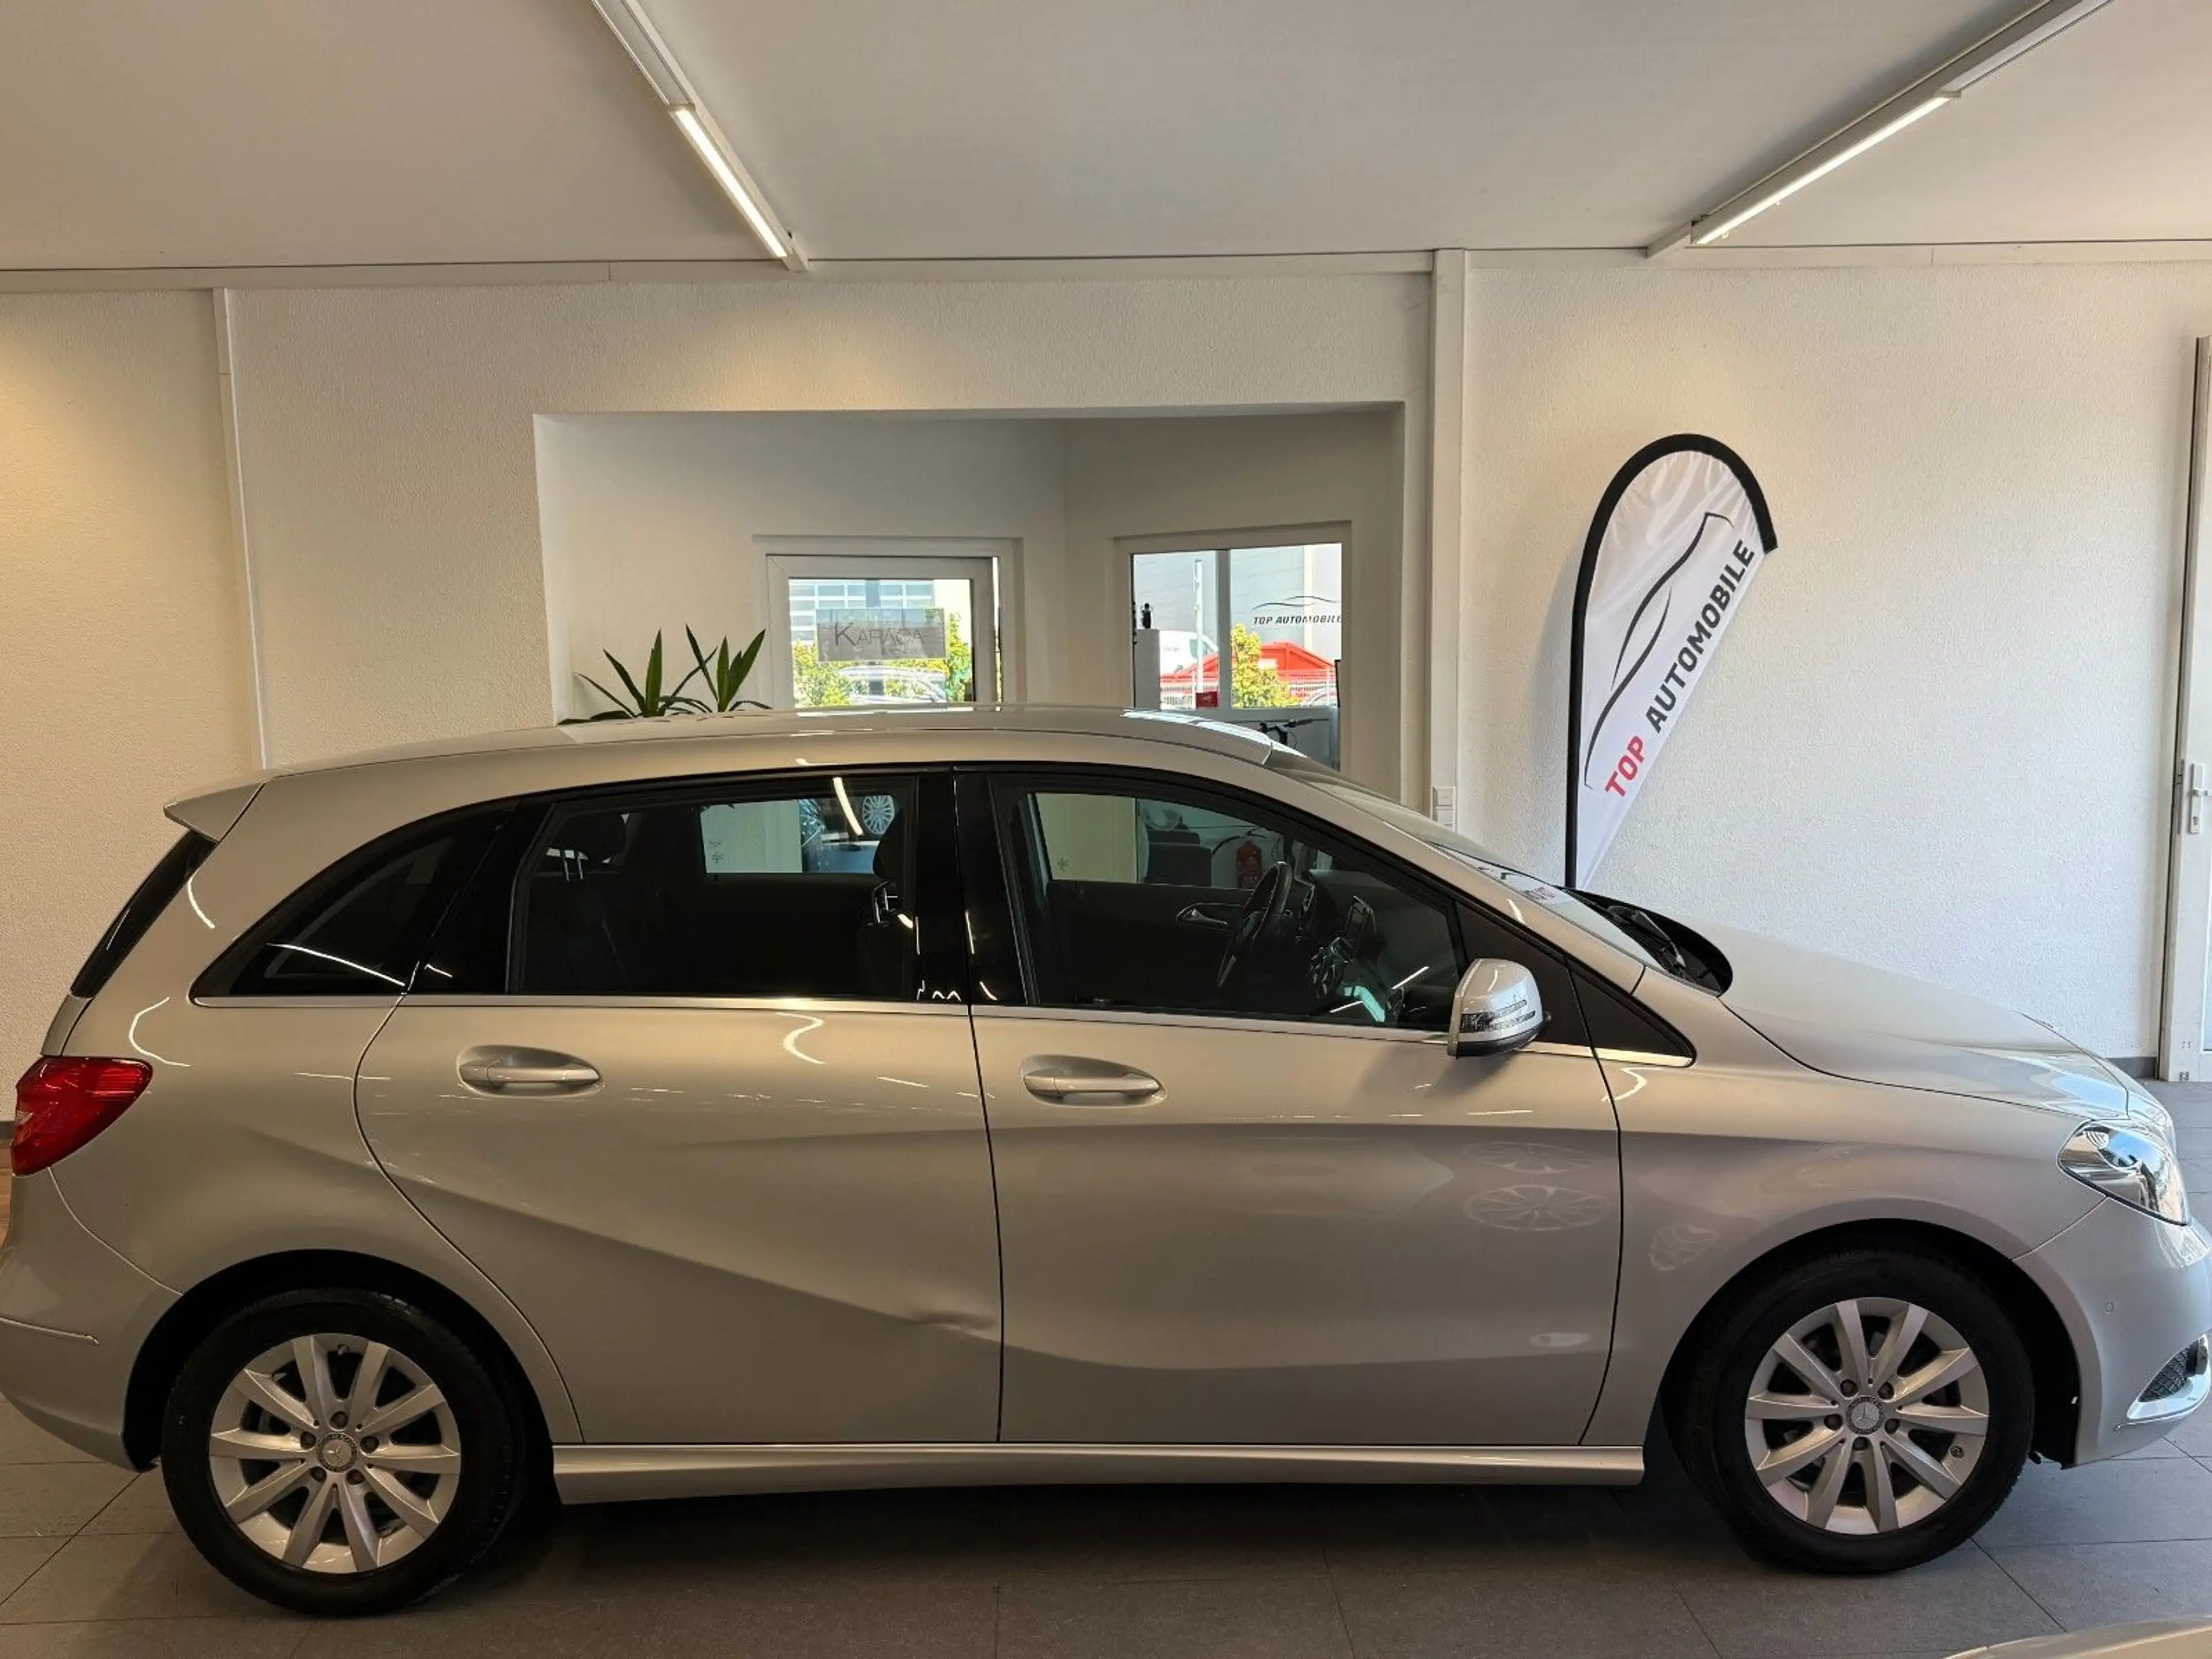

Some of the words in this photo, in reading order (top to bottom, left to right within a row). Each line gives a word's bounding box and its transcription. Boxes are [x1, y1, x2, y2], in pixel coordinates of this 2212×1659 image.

[1253, 616, 1273, 625] TOP
[1605, 735, 1645, 798] TOP
[1645, 539, 1755, 733] AUTOMOBILE
